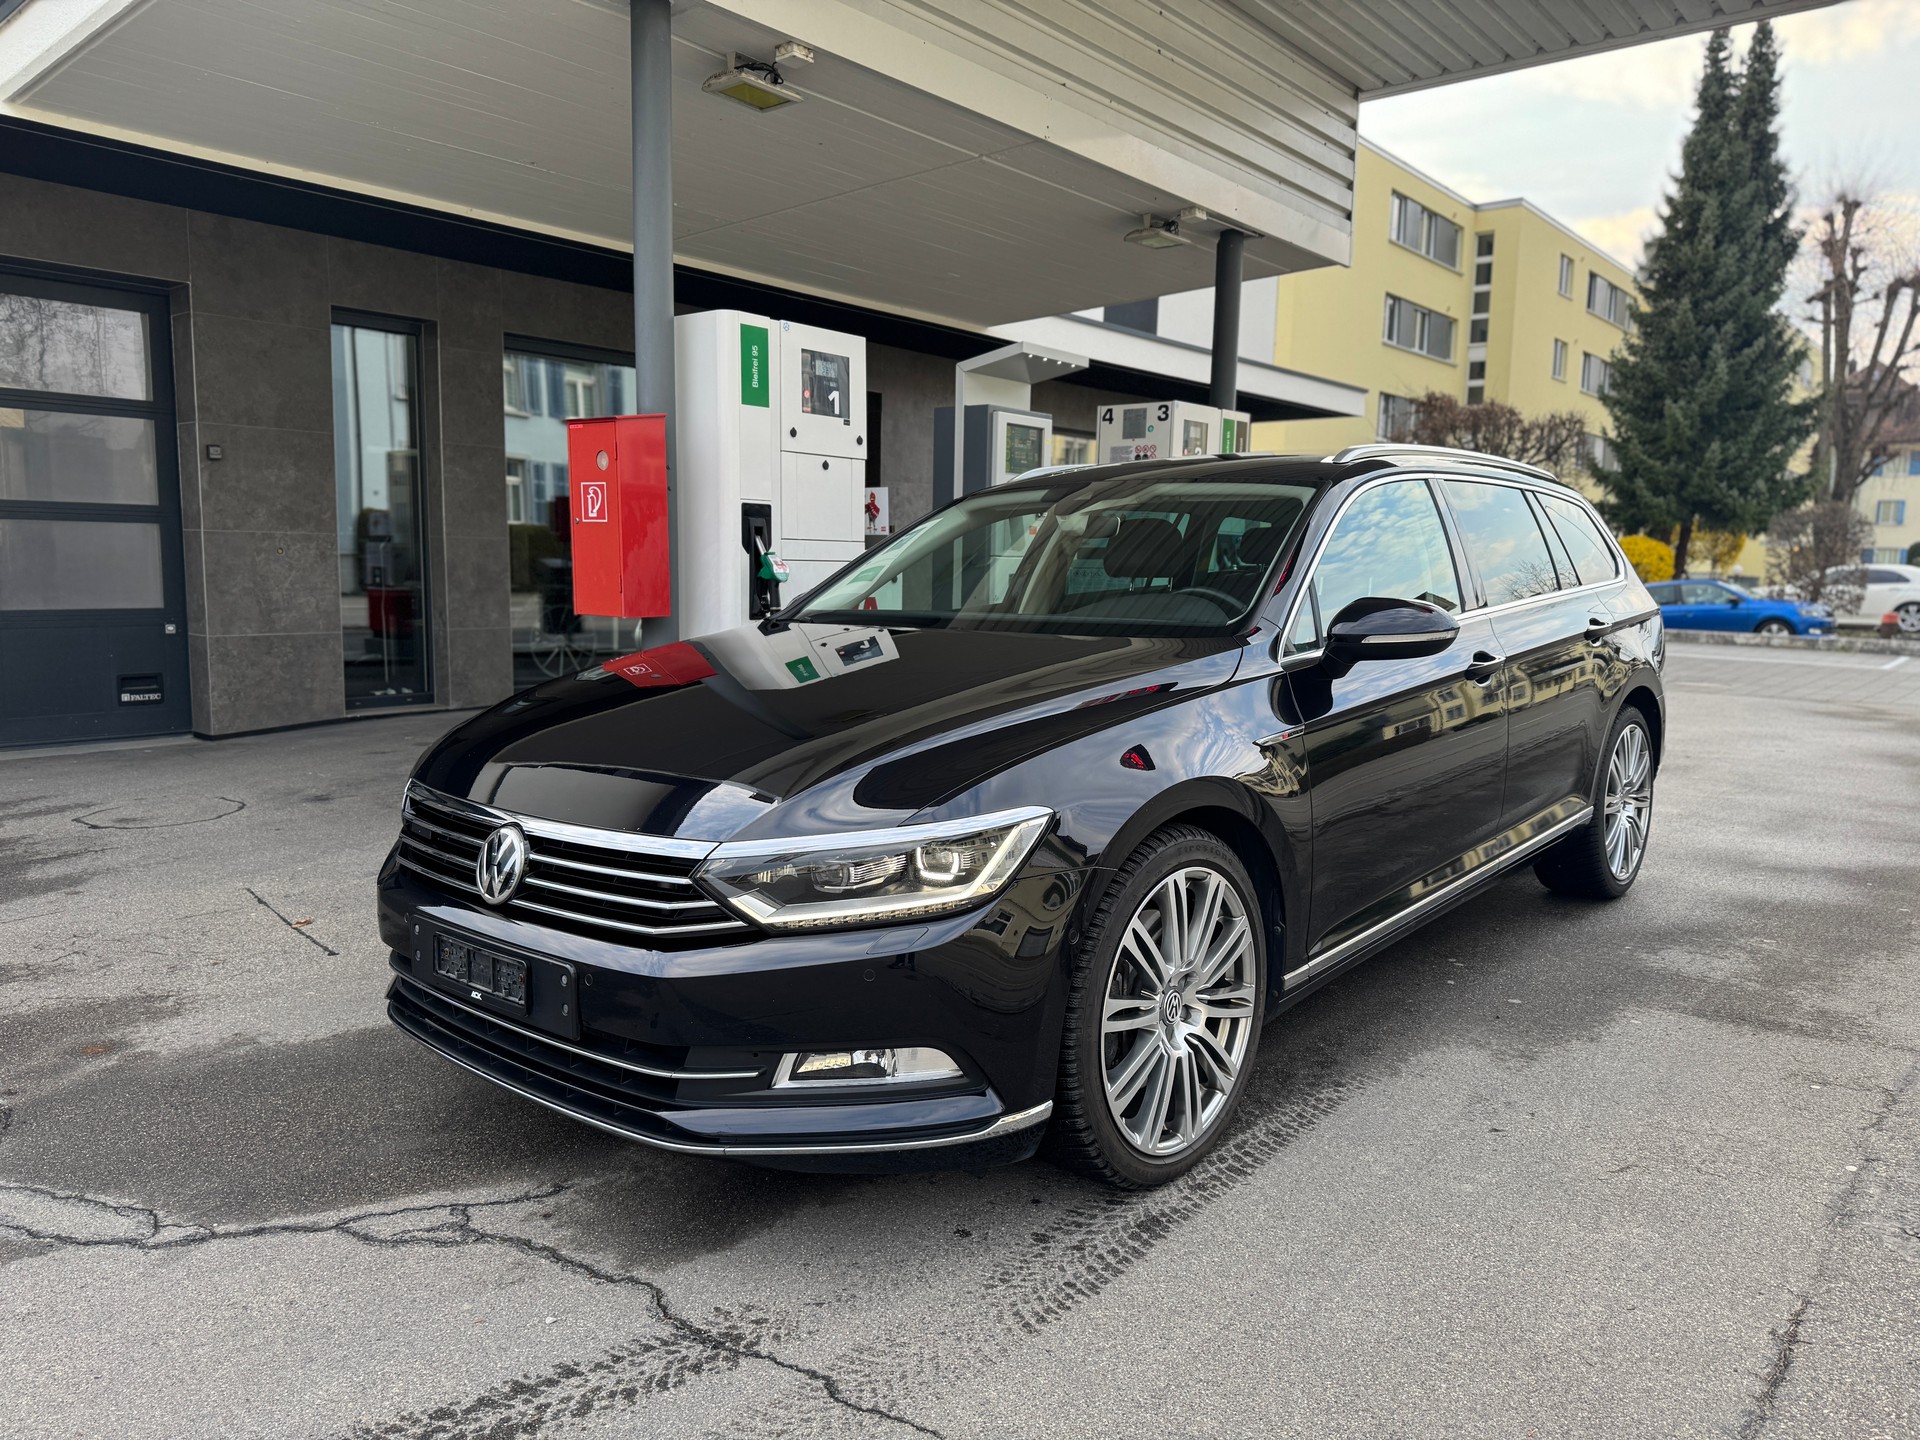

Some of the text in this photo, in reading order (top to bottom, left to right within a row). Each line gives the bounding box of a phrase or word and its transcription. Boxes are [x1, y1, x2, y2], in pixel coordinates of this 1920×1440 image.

[751, 345, 759, 388] Bleifrei 95
[828, 390, 839, 415] 1
[1157, 405, 1169, 421] 3
[1102, 408, 1114, 424] 4
[477, 827, 525, 904] VW
